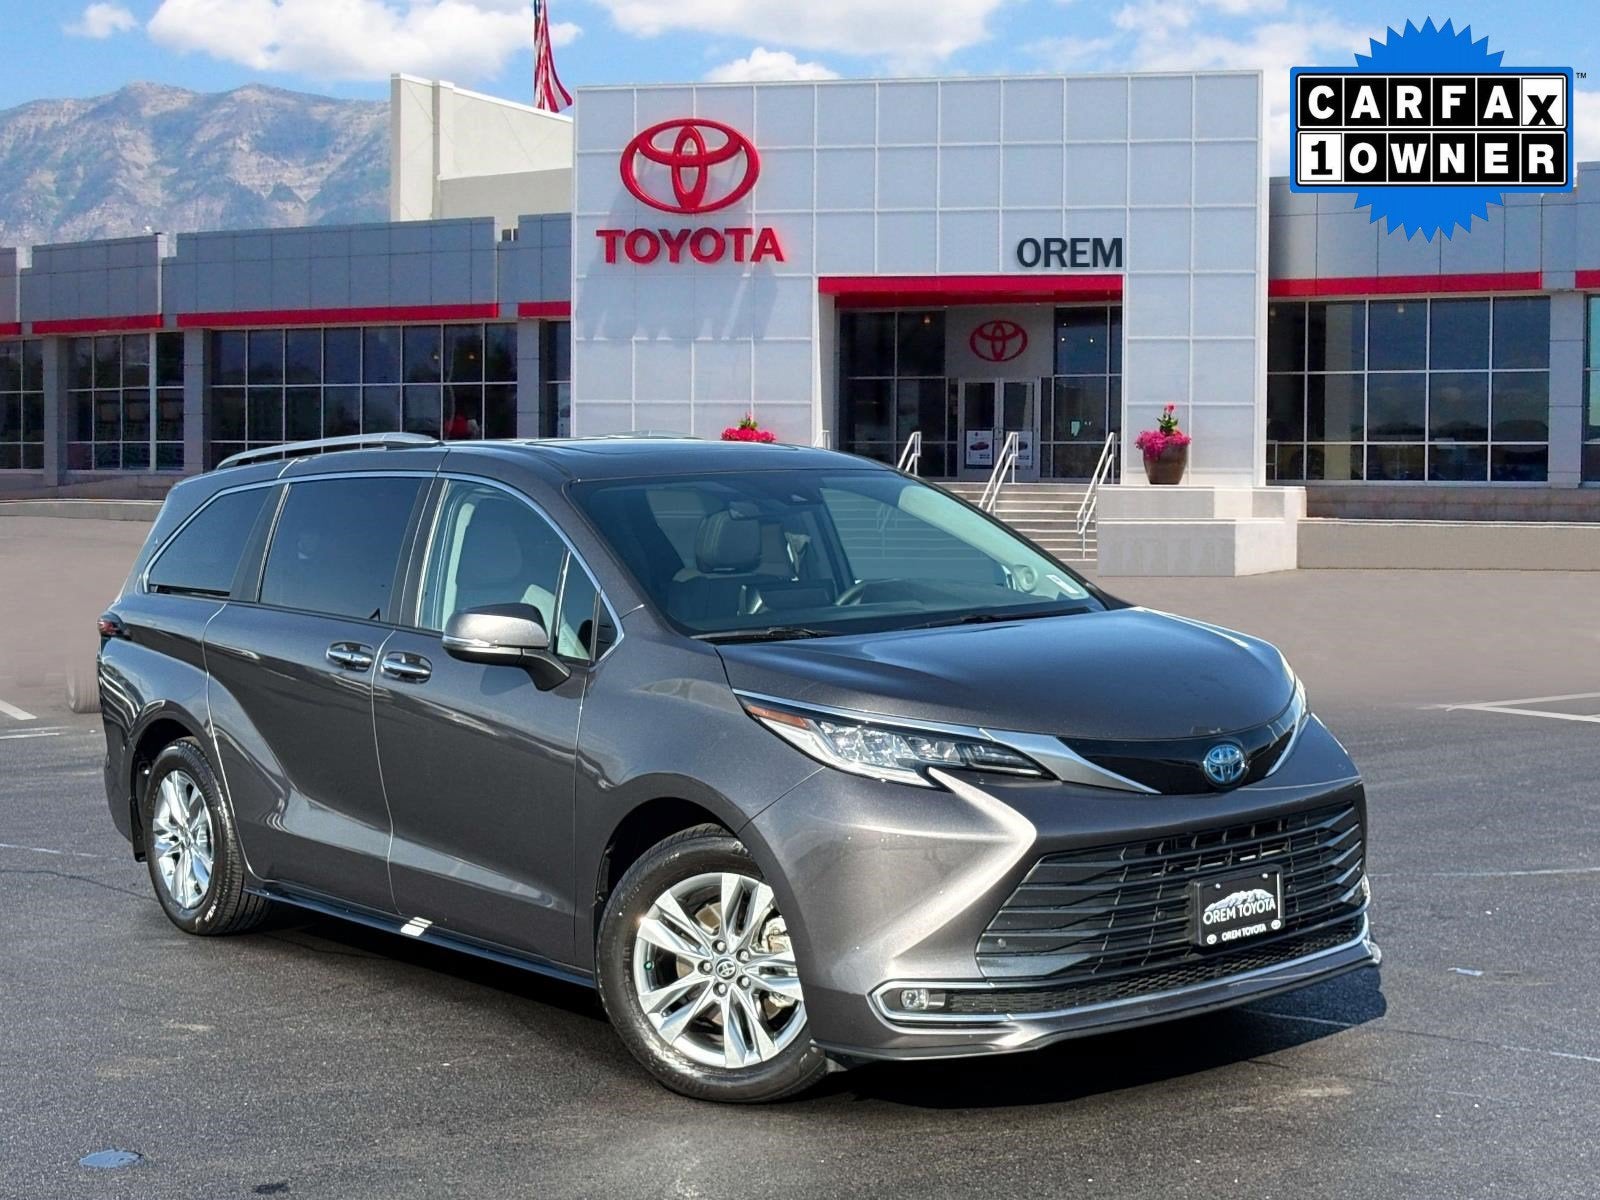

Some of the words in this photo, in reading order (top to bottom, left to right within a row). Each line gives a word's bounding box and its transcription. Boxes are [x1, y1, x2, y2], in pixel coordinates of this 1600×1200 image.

[596, 227, 784, 264] TOYOTA
[1016, 237, 1123, 268] OREM
[1203, 906, 1236, 925] OREM
[1237, 898, 1276, 917] TOYOTA
[1222, 929, 1241, 941] OREM
[1241, 923, 1266, 937] TOYOTA
